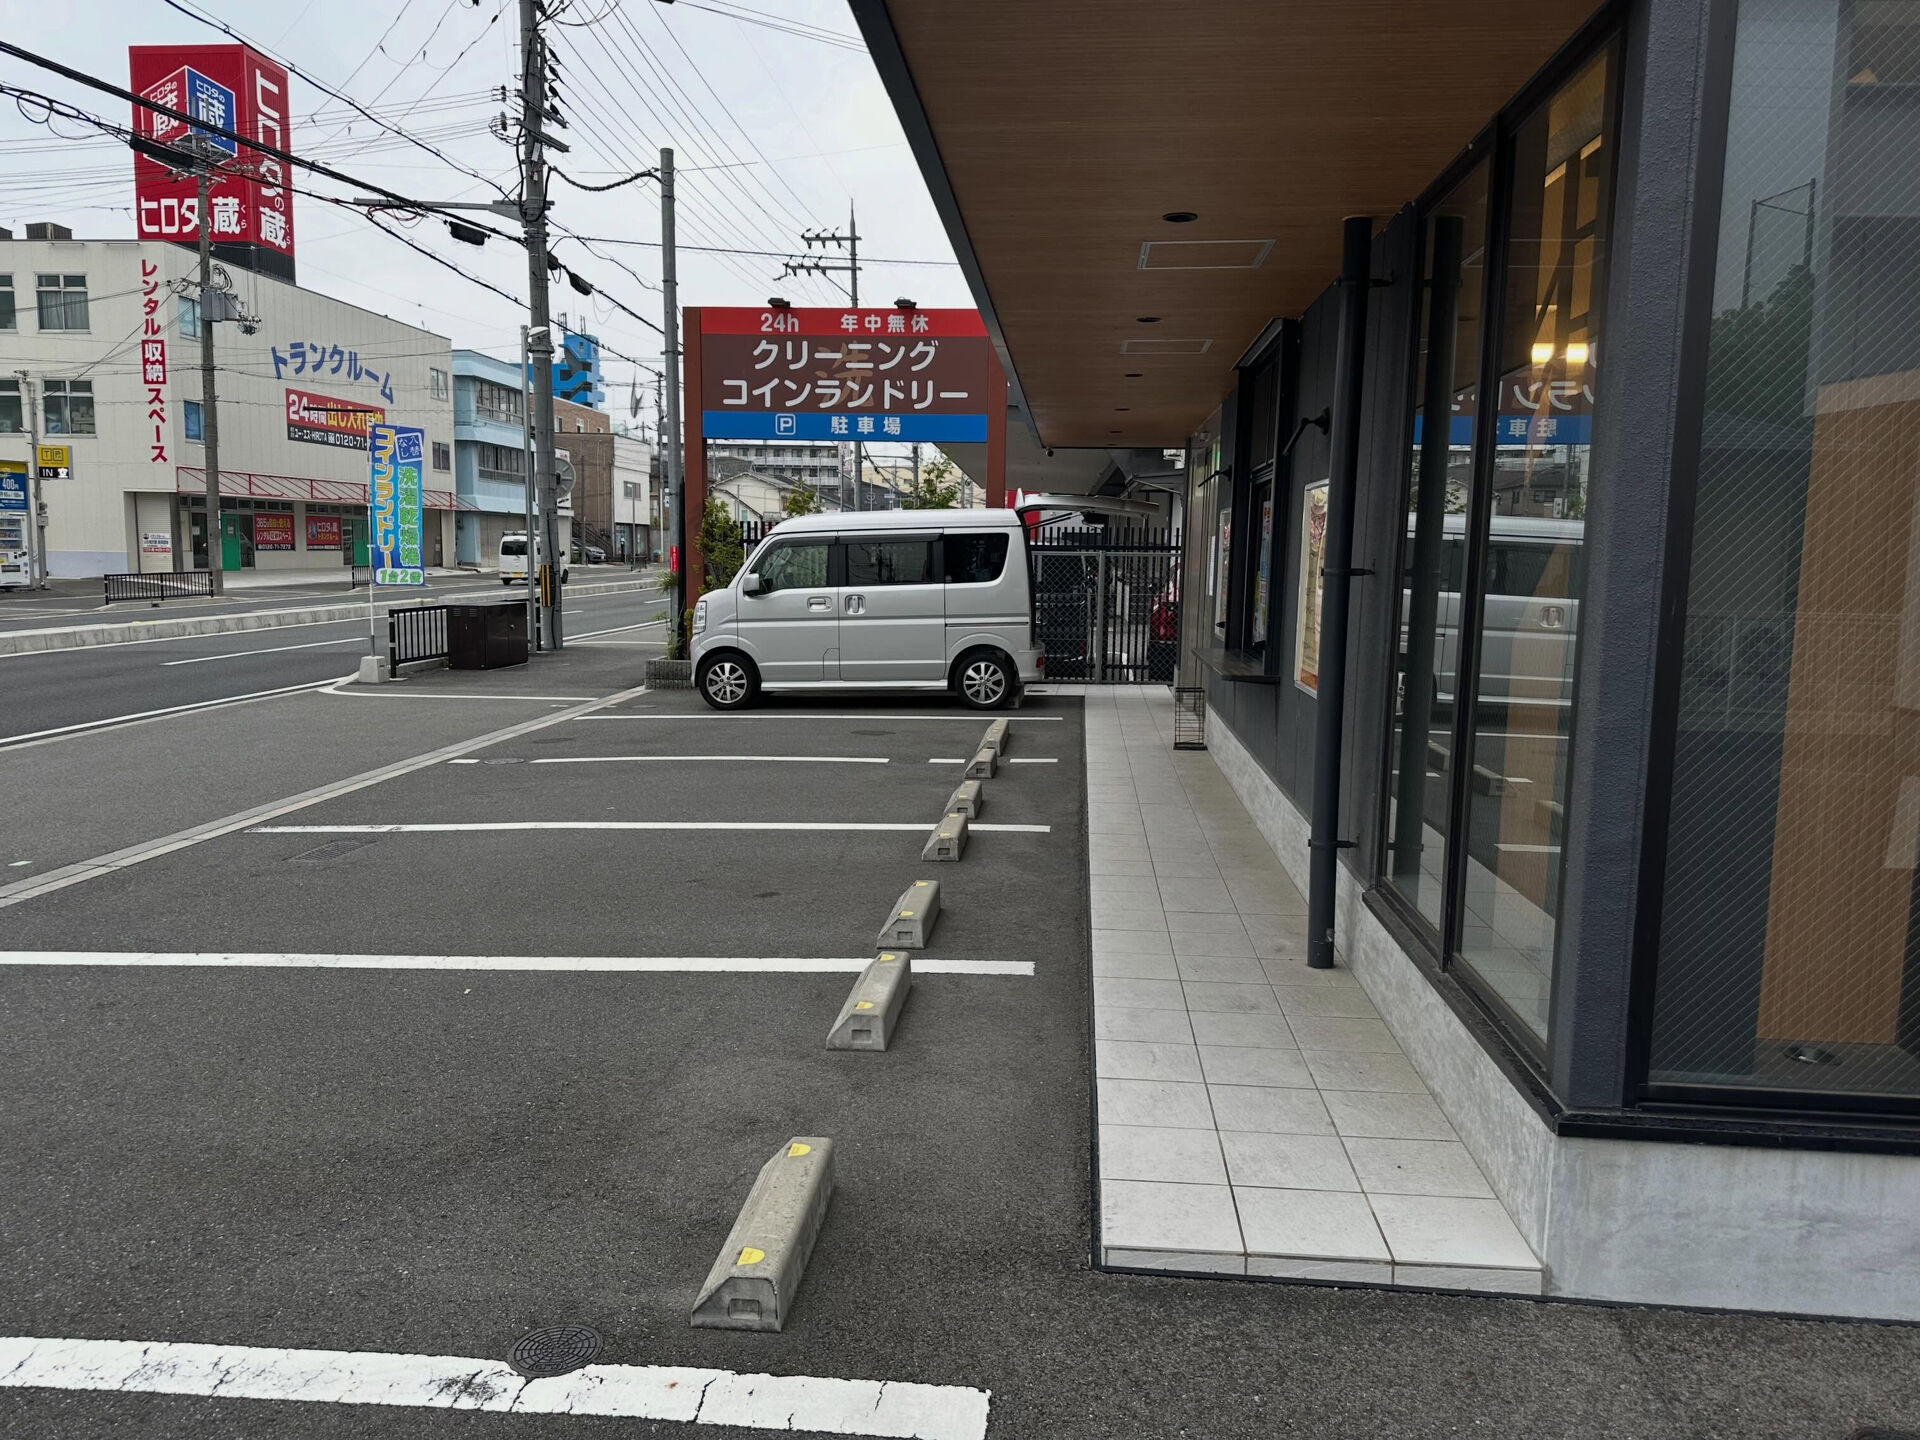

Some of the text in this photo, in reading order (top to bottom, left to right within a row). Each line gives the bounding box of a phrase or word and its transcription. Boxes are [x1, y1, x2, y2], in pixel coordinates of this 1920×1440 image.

[140, 195, 241, 235] ヒロタ蔵
[760, 313, 800, 333] 24h
[840, 313, 930, 334] 年中無休
[752, 339, 939, 372] クリーニング
[271, 341, 394, 405] トランクルーム
[722, 377, 969, 410] コインランドリー
[830, 415, 902, 436] 駐車場
[42, 468, 53, 477] IN
[374, 428, 395, 569] コインランドリー
